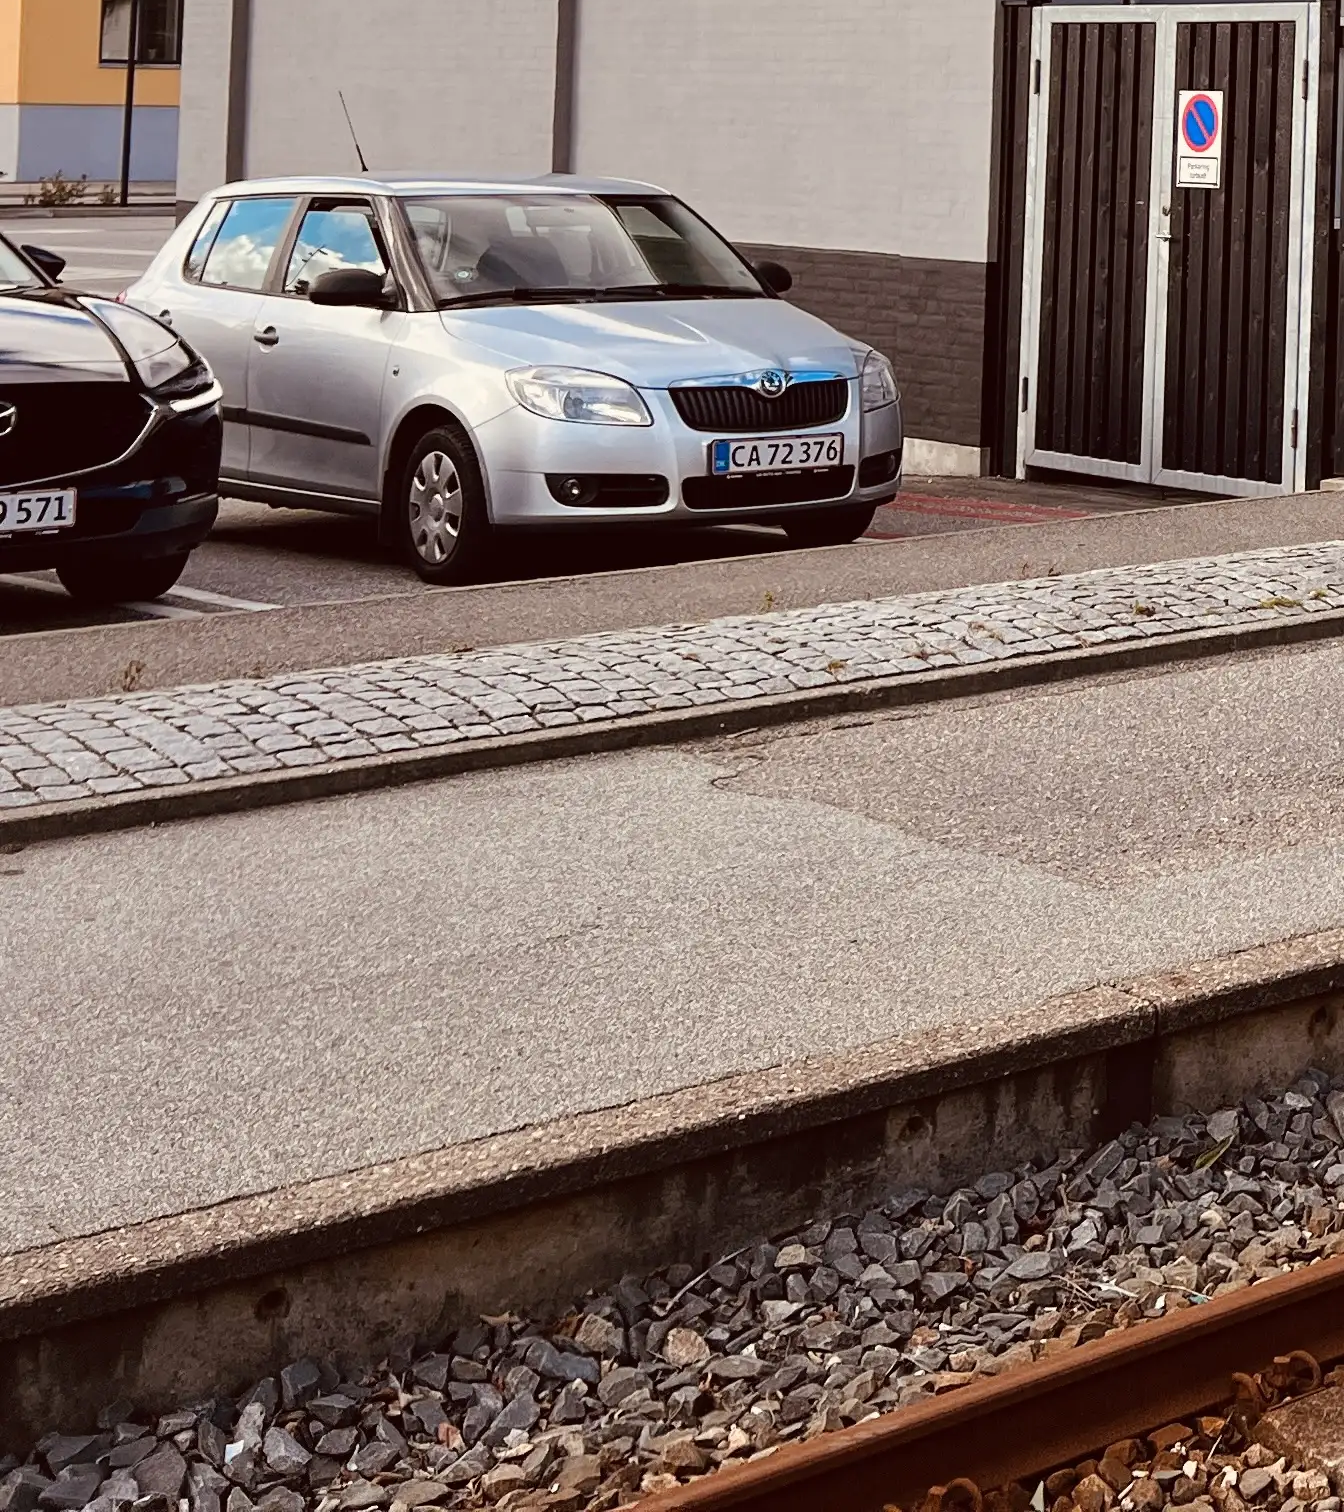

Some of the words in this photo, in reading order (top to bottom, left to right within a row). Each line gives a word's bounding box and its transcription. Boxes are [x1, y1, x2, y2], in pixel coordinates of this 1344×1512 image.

[731, 444, 761, 467] CA
[767, 443, 794, 466] 72
[798, 439, 838, 464] 376
[16, 495, 67, 524] 571
